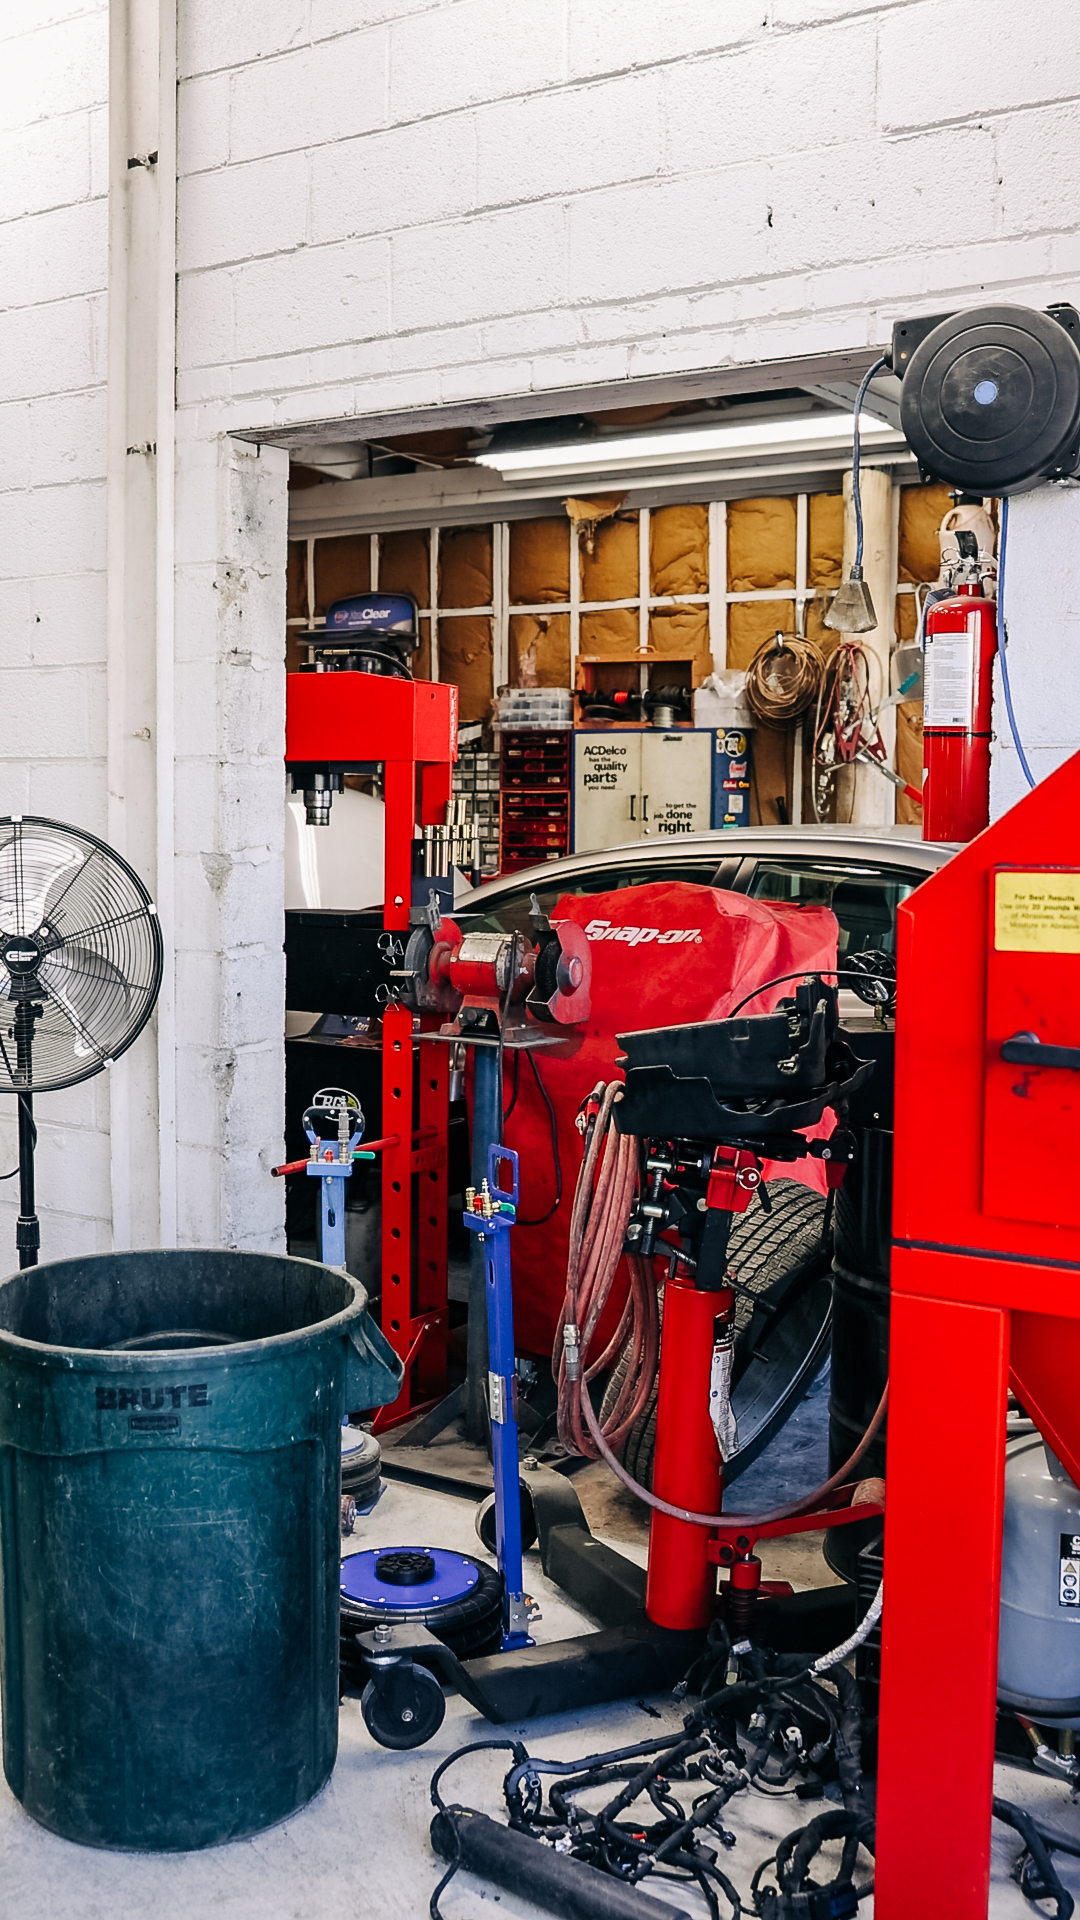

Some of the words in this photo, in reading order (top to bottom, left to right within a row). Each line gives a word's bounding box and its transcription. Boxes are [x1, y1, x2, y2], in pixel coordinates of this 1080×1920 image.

[584, 745, 627, 755] ACDelco
[594, 761, 628, 773] quality
[584, 772, 618, 786] parts
[666, 809, 693, 819] done
[658, 819, 695, 835] right.
[1048, 894, 1075, 902] Results
[96, 1383, 213, 1411] BRUTE
